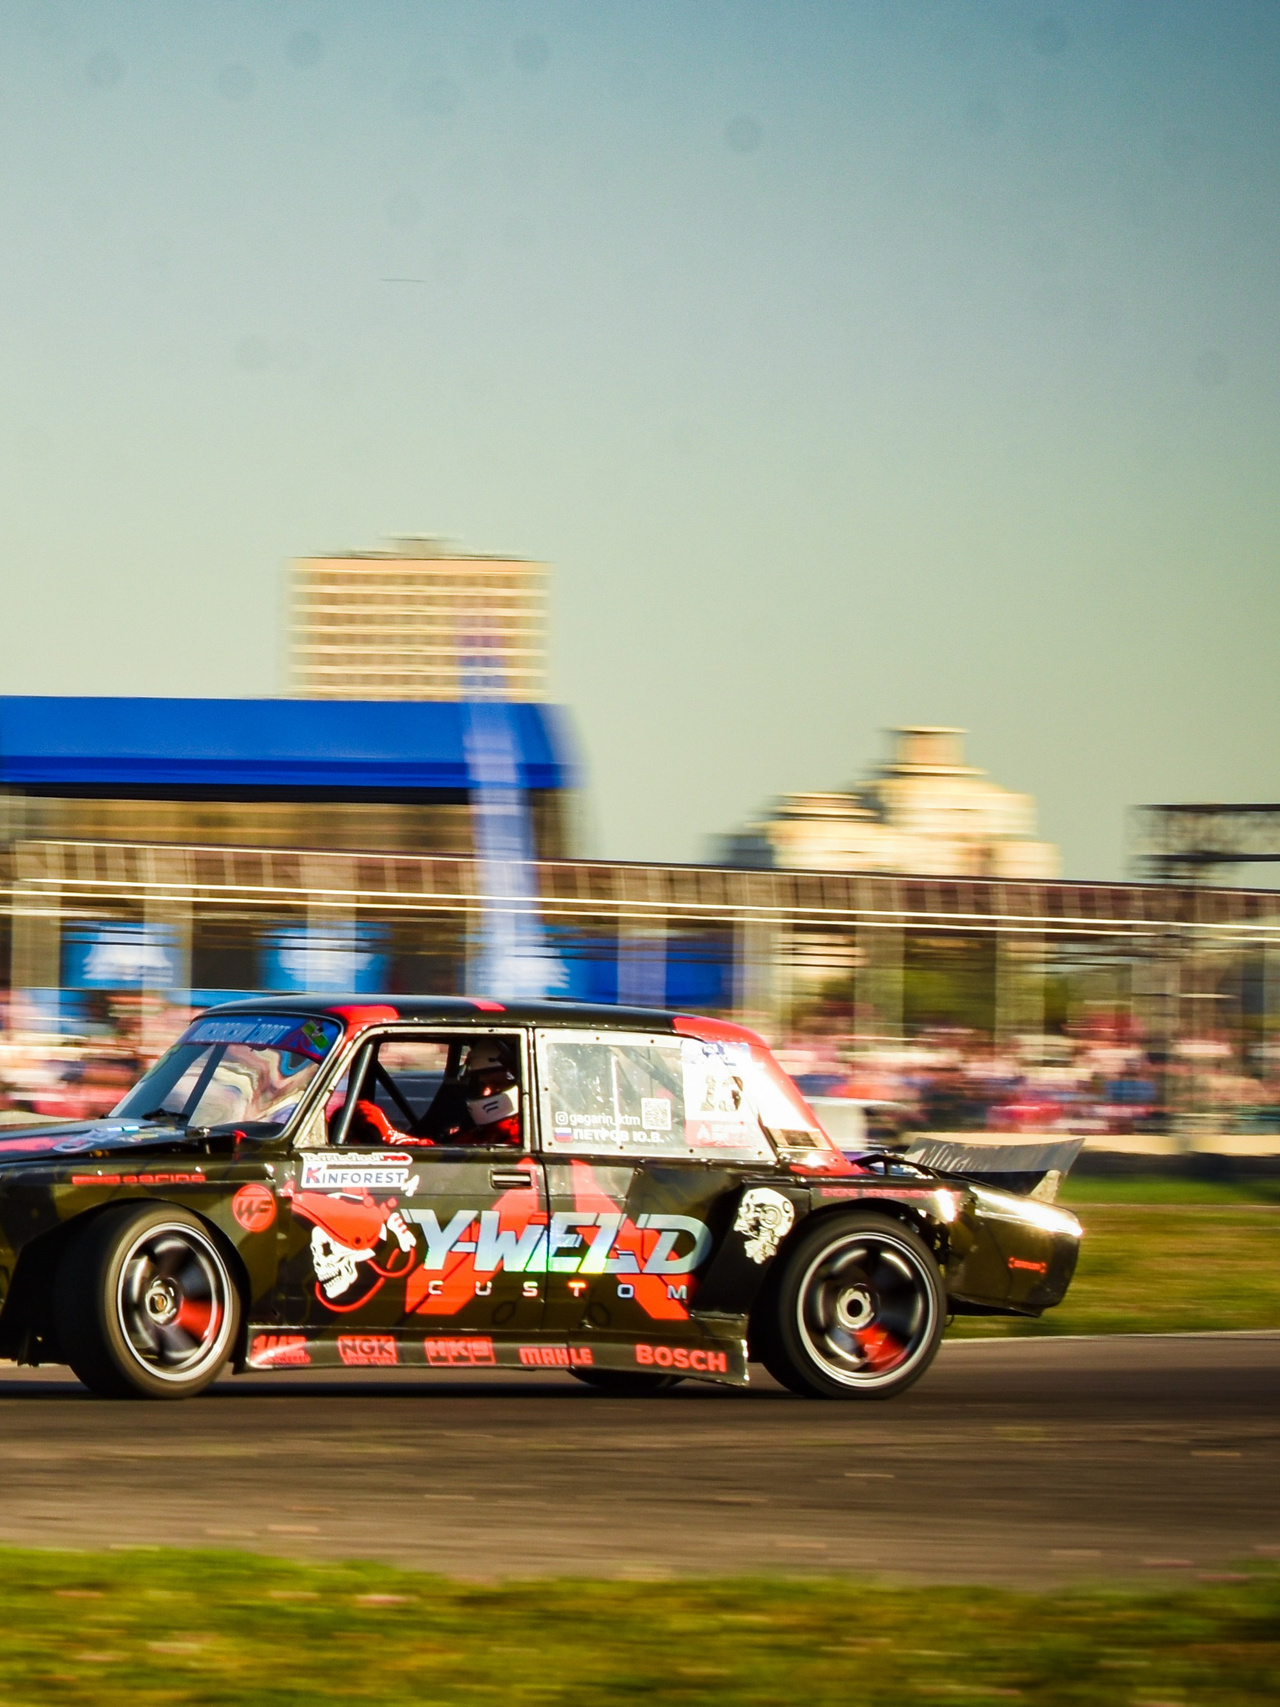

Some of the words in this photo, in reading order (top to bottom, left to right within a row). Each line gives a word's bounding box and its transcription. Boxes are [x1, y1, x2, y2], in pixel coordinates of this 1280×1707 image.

[573, 1128, 629, 1142] ПЕТРОВ
[306, 1167, 405, 1184] KINFOREST
[400, 1209, 713, 1274] Y-WELD
[428, 1280, 687, 1299] CUSTOM
[339, 1338, 394, 1356] NGK
[427, 1340, 488, 1358] HKS
[519, 1346, 594, 1366] MAHLE
[635, 1344, 727, 1373] BOSCH
